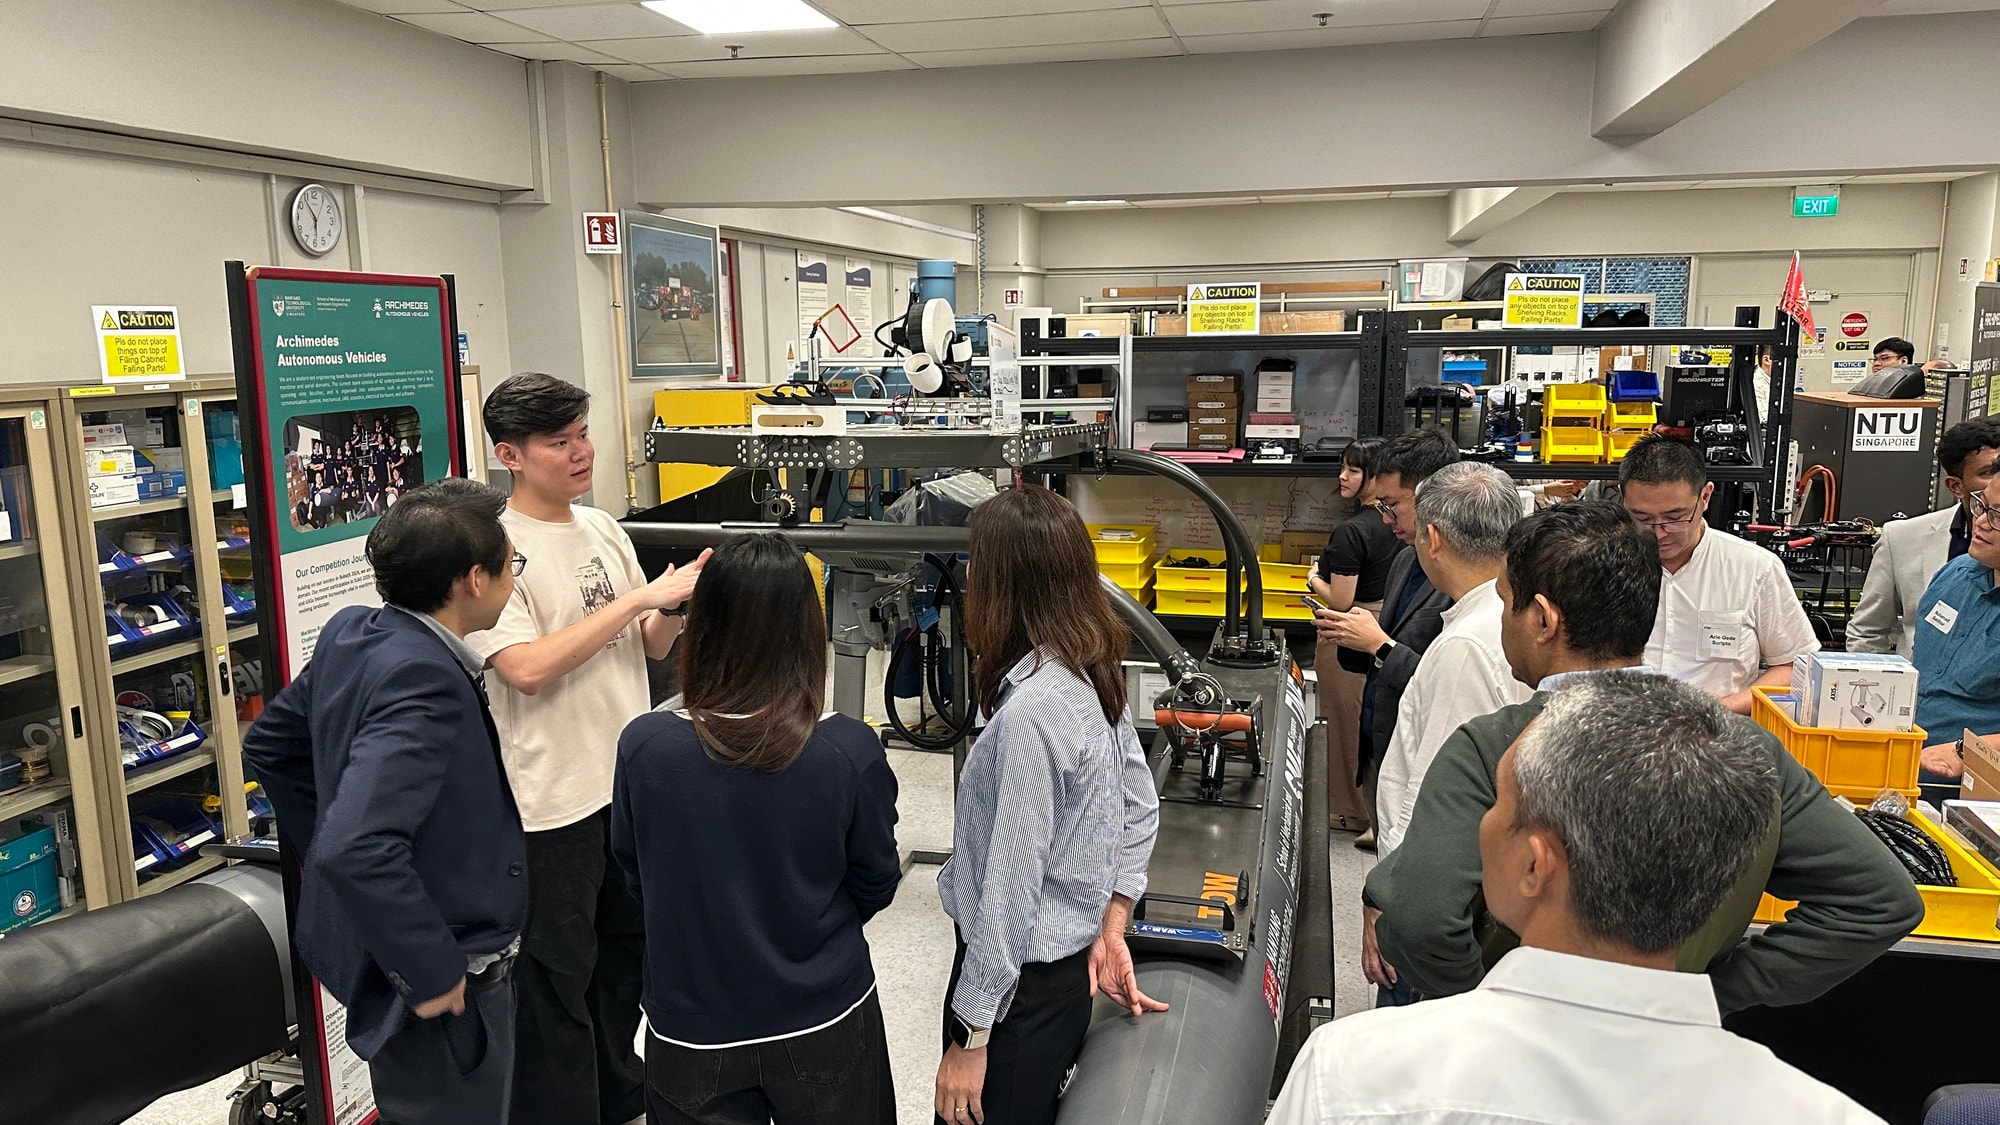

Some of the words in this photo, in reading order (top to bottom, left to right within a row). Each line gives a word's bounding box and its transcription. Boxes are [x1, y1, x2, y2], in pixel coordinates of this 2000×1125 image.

[327, 205, 331, 214] 2
[1802, 200, 1830, 214] EXIT
[329, 217, 334, 225] 3
[305, 235, 309, 243] 7
[313, 239, 317, 247] 6
[321, 237, 325, 246] 5
[1528, 279, 1579, 288] CAUTION
[1208, 288, 1255, 297] CAUTION
[385, 301, 428, 310] ARCHIMEDES
[1785, 302, 1808, 326] CLEAR
[120, 314, 173, 326] CAUTION
[150, 338, 167, 348] place
[276, 335, 340, 348] Archimedes
[117, 347, 137, 356] things
[278, 354, 343, 366] Autonomous
[345, 351, 386, 363] Vehicles
[123, 365, 145, 374] Falling
[1857, 413, 1919, 434] NTU
[1855, 438, 1916, 446] SINGAPORE
[296, 568, 309, 578] Our
[310, 557, 350, 574] Competition
[352, 554, 366, 564] Jour
[1265, 908, 1282, 971] NANYANG
